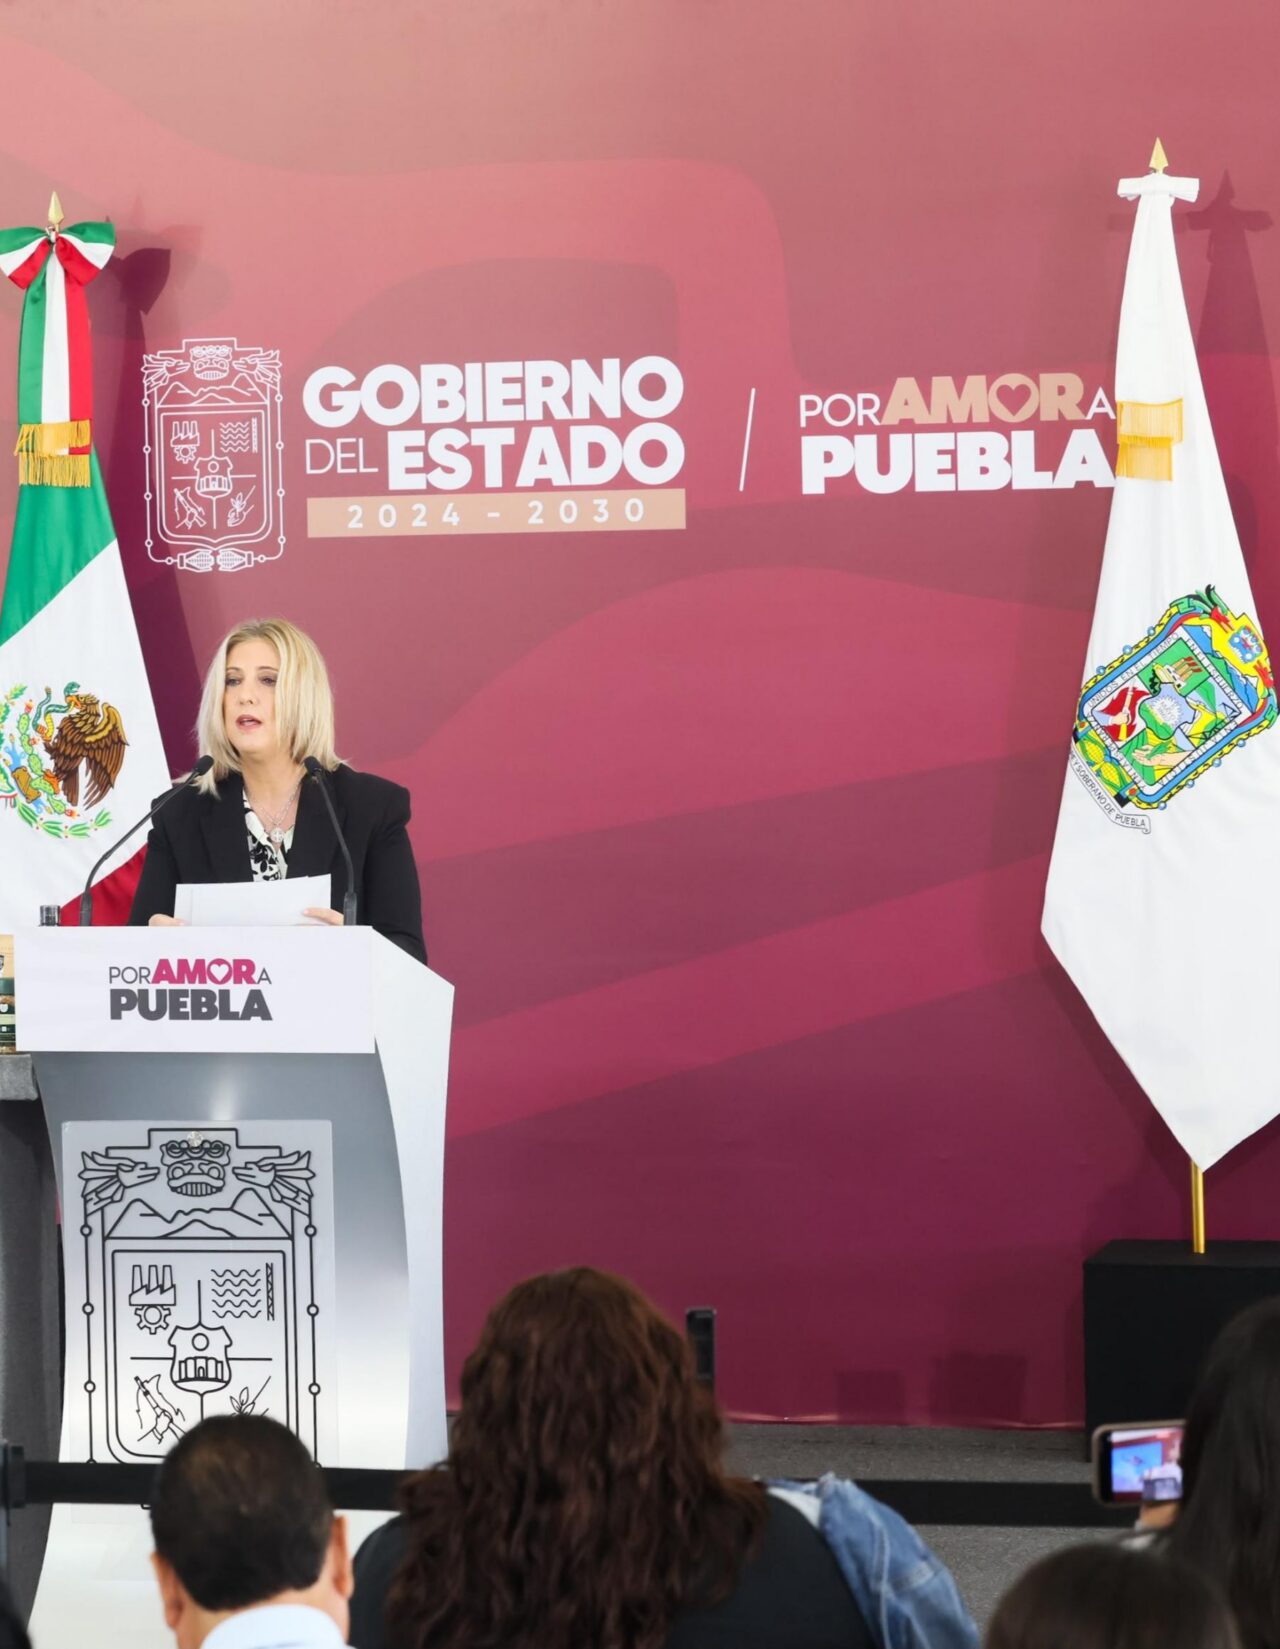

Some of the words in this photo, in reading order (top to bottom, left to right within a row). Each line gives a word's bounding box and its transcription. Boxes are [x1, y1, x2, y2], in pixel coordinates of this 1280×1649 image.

[303, 355, 683, 428] GOBIERNO
[800, 393, 881, 427] POR
[881, 373, 1086, 425] AMOR
[1086, 387, 1116, 419] A
[306, 437, 379, 474] DEL
[388, 421, 686, 490] ESTADO
[801, 428, 1116, 494] PUEBLA
[347, 503, 460, 529] 2024
[528, 497, 644, 524] 2030
[1075, 763, 1107, 805] SOBERANO
[1103, 802, 1116, 815] DE
[1115, 813, 1146, 827] PUEBLA
[109, 966, 151, 984] POR
[151, 958, 257, 985] AMOR
[257, 967, 272, 985] A
[110, 989, 273, 1021] PUEBLA
